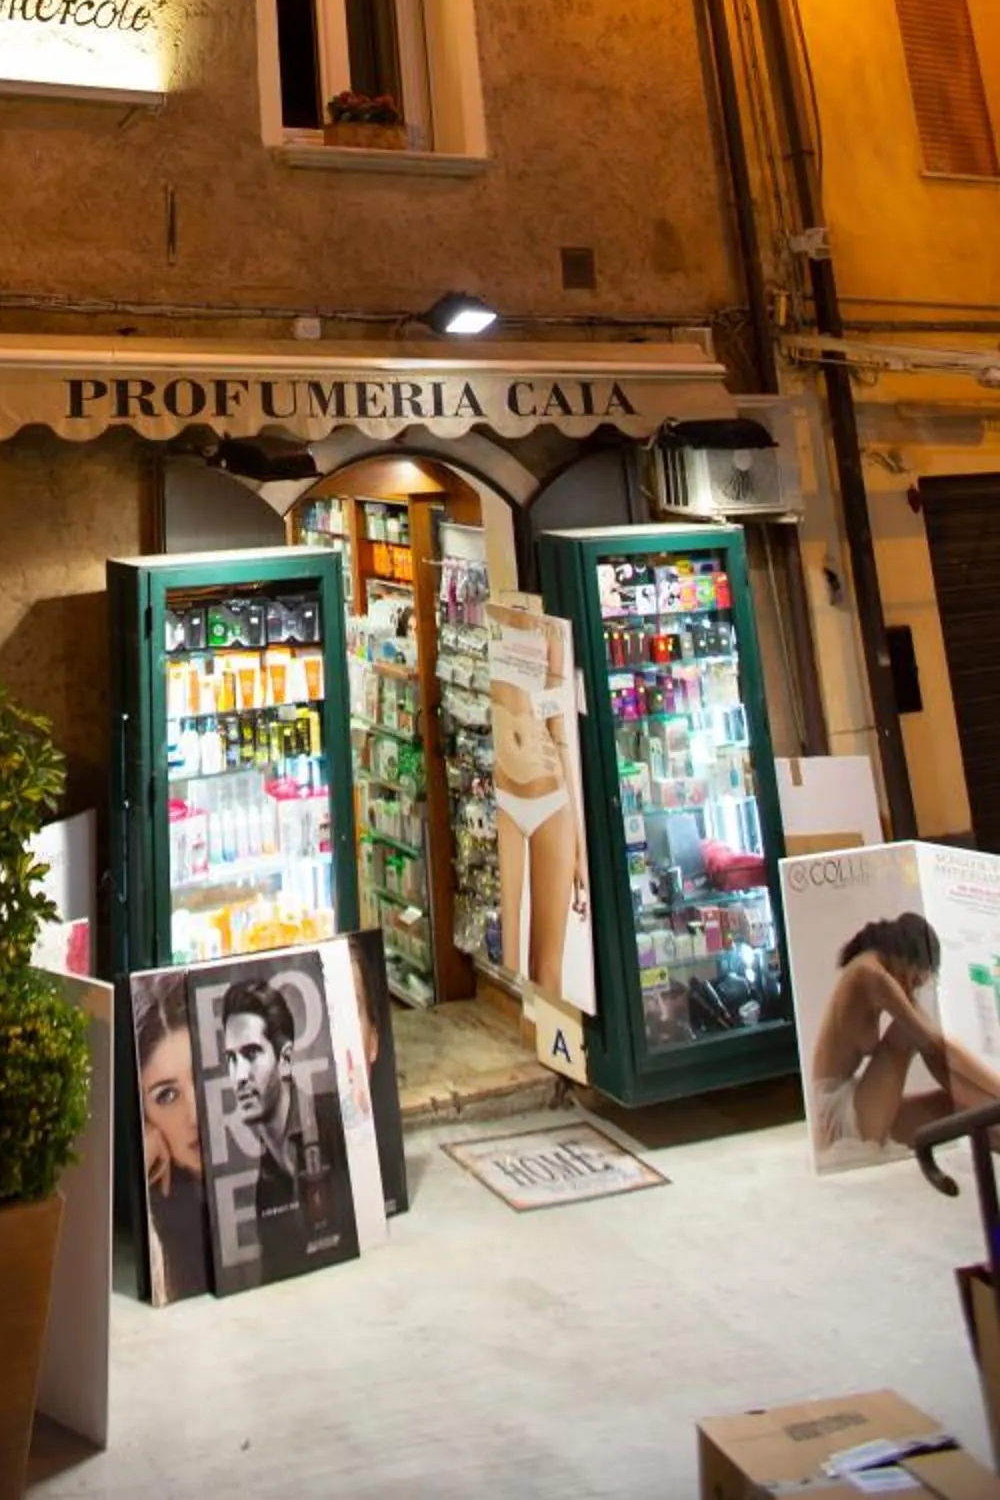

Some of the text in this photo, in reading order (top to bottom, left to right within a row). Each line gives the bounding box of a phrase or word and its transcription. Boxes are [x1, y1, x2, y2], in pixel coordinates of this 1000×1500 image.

[63, 377, 641, 419] PROFUMERIA CAIA
[551, 1027, 572, 1063] A
[493, 1139, 614, 1187] HOME
